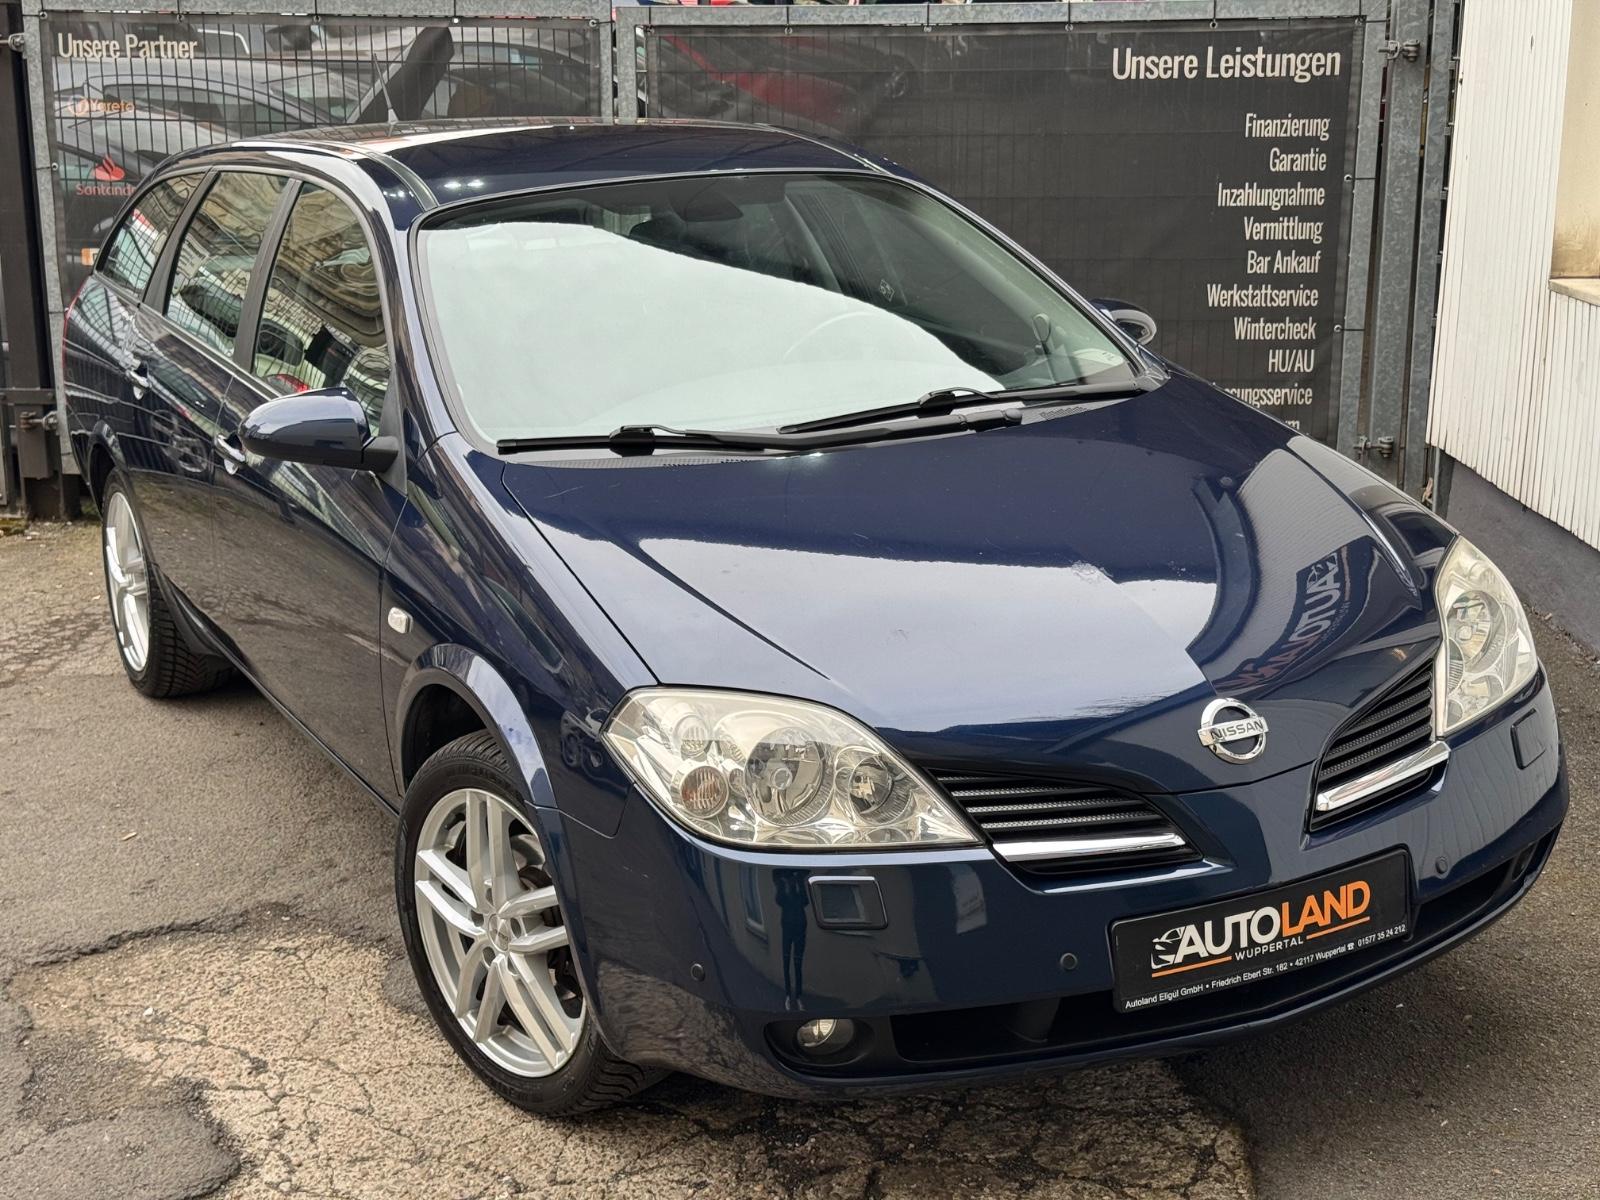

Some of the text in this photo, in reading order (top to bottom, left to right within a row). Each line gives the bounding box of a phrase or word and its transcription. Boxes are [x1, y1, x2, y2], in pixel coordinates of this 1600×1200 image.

[57, 32, 198, 59] Unsere Partner
[1112, 46, 1341, 83] Unsere Leistungen
[1245, 113, 1330, 141] Finanzierung
[1269, 147, 1327, 172] Garantie
[1217, 182, 1325, 211] Inzahlungnahme
[1244, 216, 1323, 244] Vermittlung
[1247, 249, 1321, 274] Bar Ankauf
[1207, 284, 1319, 308] Werkstattservice
[1234, 316, 1317, 340] Wintercheck
[1268, 349, 1315, 373] HU/AU
[1210, 719, 1264, 740] NISSAN
[1235, 936, 1304, 961] WUPPERTAL
[1125, 994, 1158, 1009] Autoland
[1180, 984, 1204, 997] GmbH
[1211, 975, 1242, 989] Friedrich
[1243, 969, 1261, 981] Ebert
[1262, 967, 1275, 976] Str.
[1294, 955, 1314, 967] 42117
[1315, 944, 1346, 961] Wuppertal
[1357, 934, 1376, 947] 01577
[1377, 930, 1385, 940] 35
[1386, 928, 1394, 938] 24
[1395, 924, 1406, 935] 212
